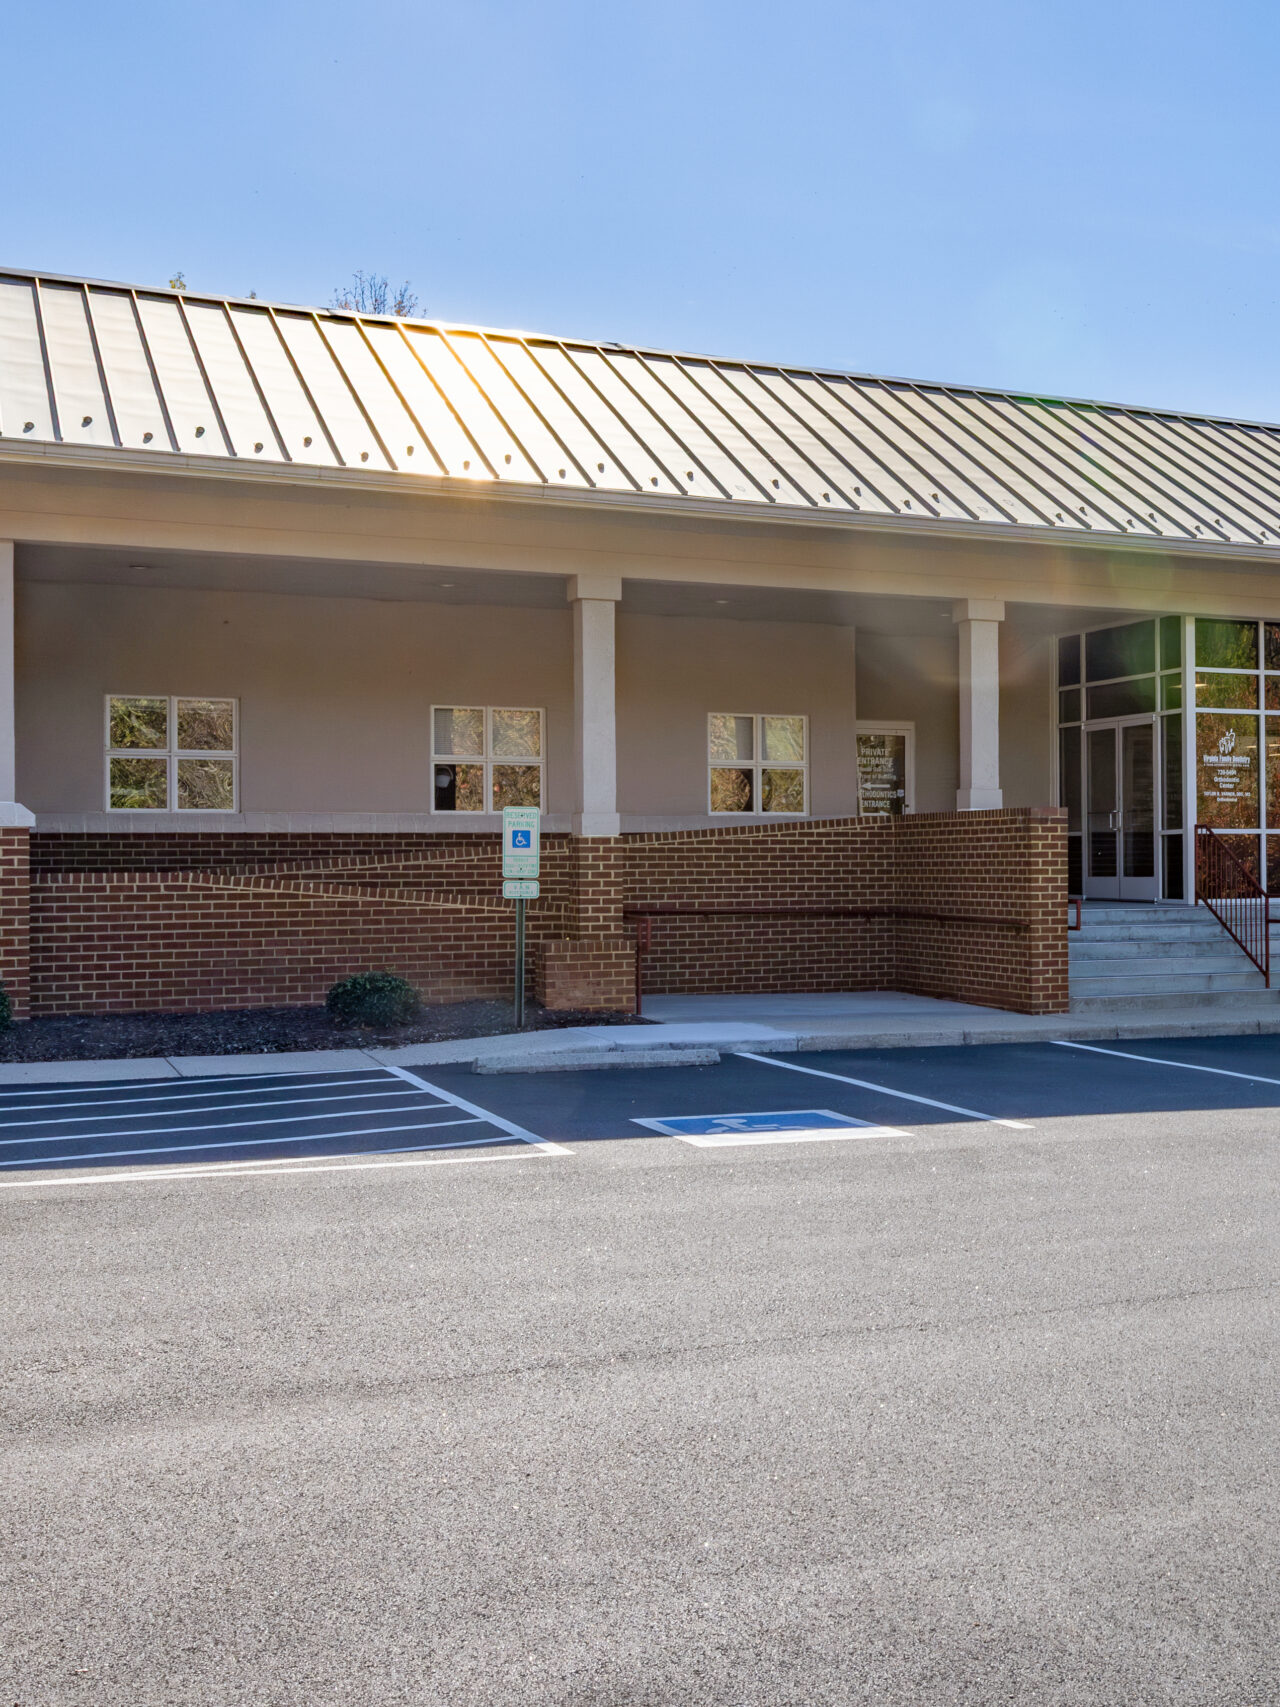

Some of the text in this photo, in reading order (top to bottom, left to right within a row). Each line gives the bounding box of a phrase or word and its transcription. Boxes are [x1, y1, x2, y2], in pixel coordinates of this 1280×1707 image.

[861, 748, 889, 756] PRIVATE
[856, 757, 893, 765] ENTRANCE
[858, 790, 897, 798] THODONTICS
[861, 800, 891, 808] ENTRANCE
[505, 811, 537, 819] RESERVED
[508, 820, 535, 829] PARKING
